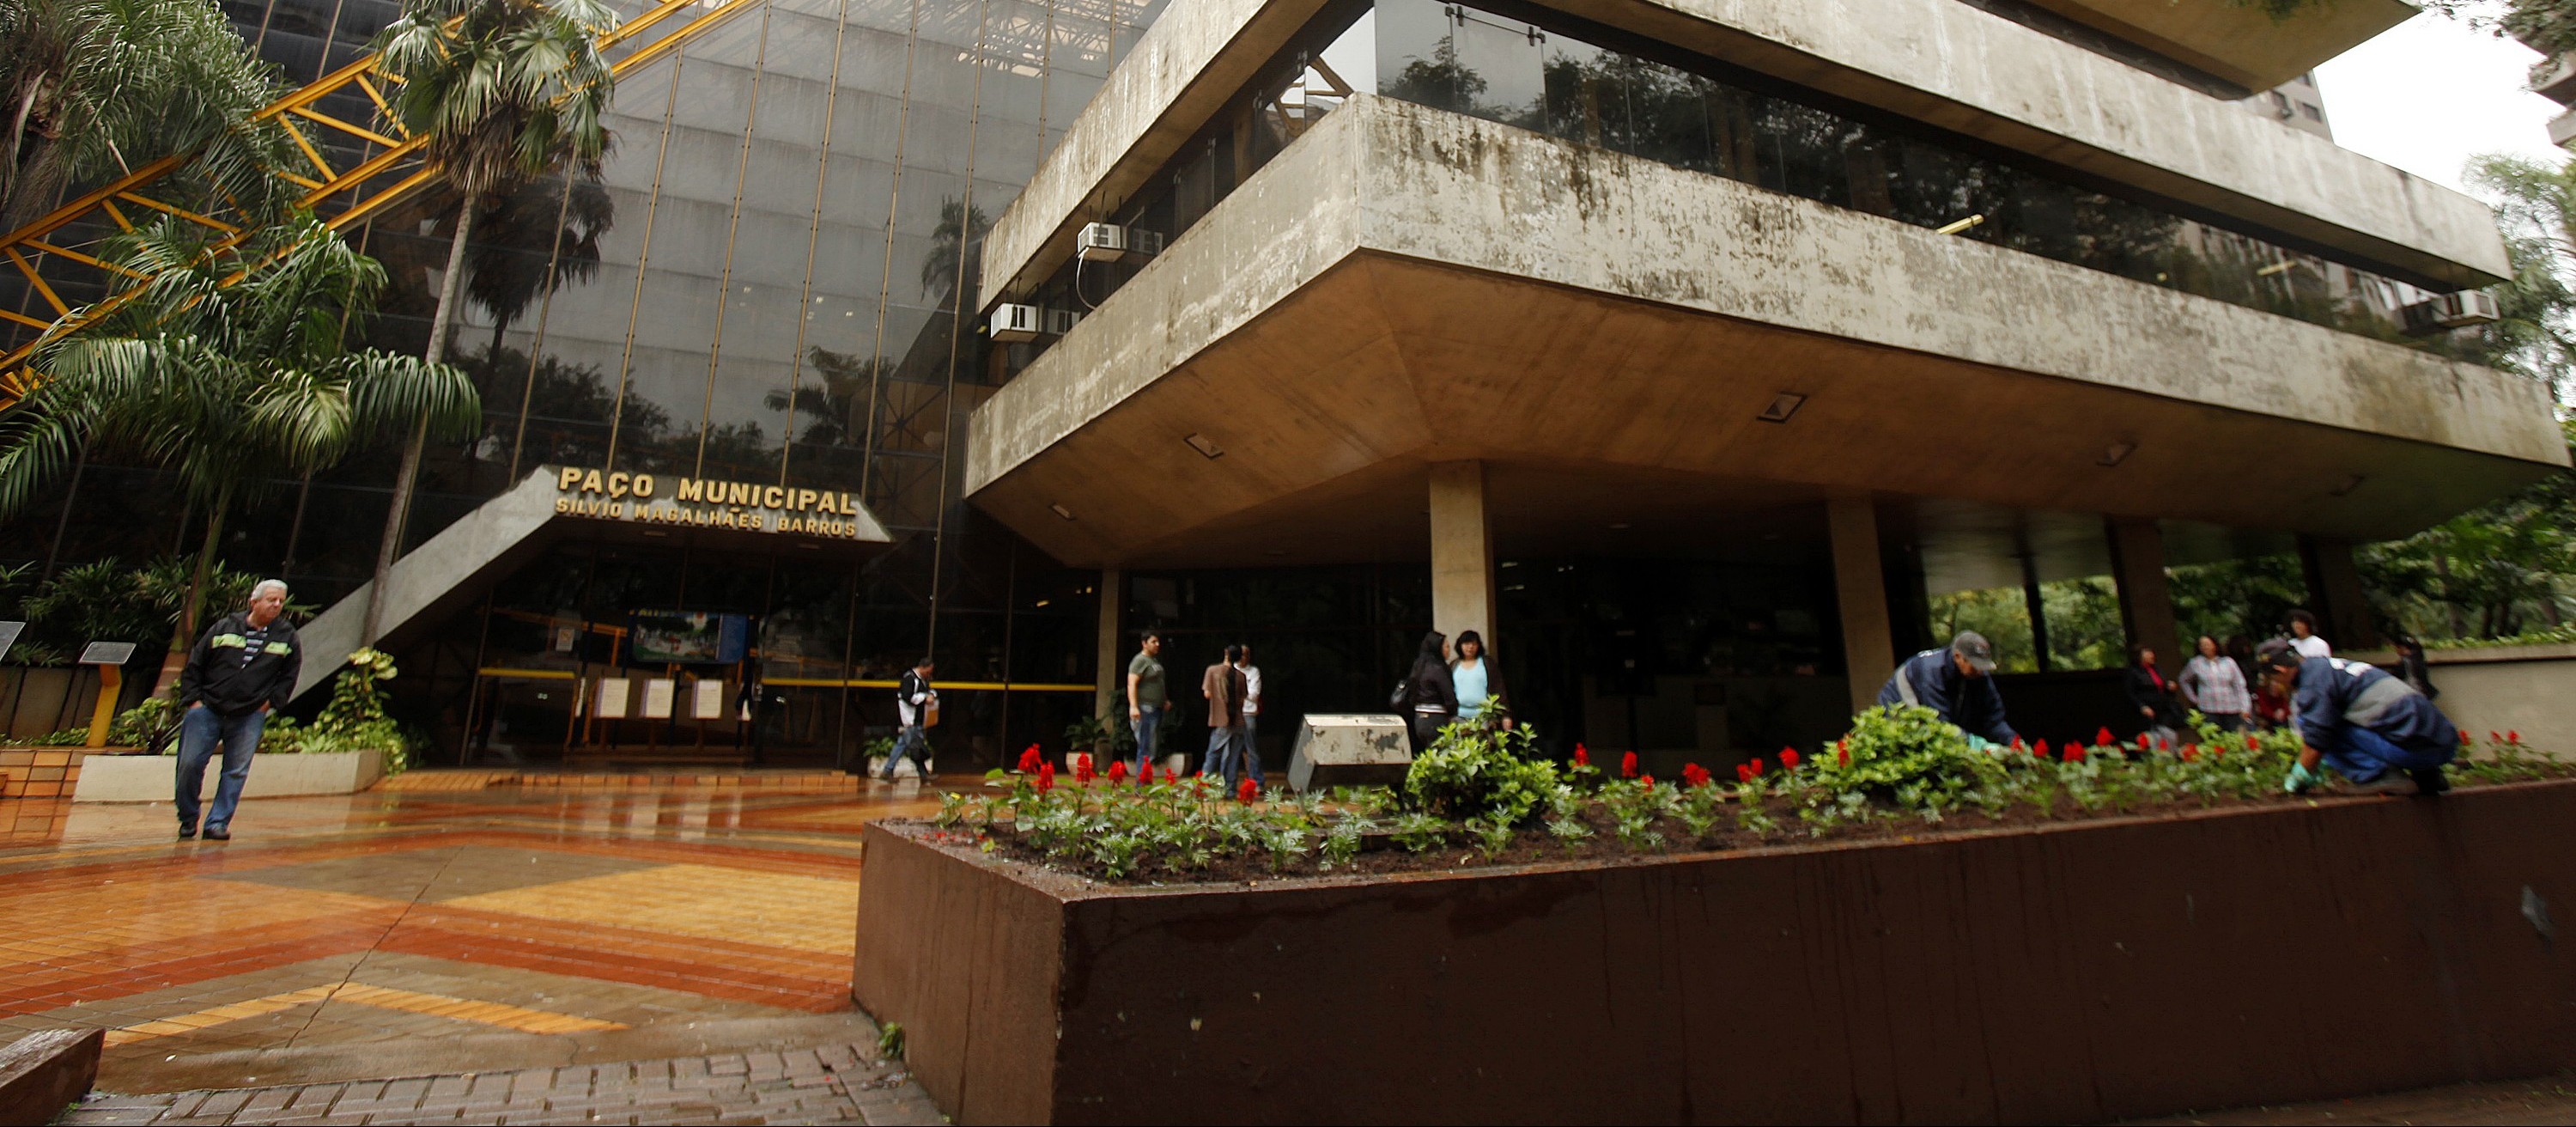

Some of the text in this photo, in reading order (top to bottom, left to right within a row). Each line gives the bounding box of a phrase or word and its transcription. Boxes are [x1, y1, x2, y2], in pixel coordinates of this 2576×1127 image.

[559, 466, 857, 515] PAÇO MUNICIPAL
[556, 497, 856, 537] SILVIO MAGALHÃES BARROS
